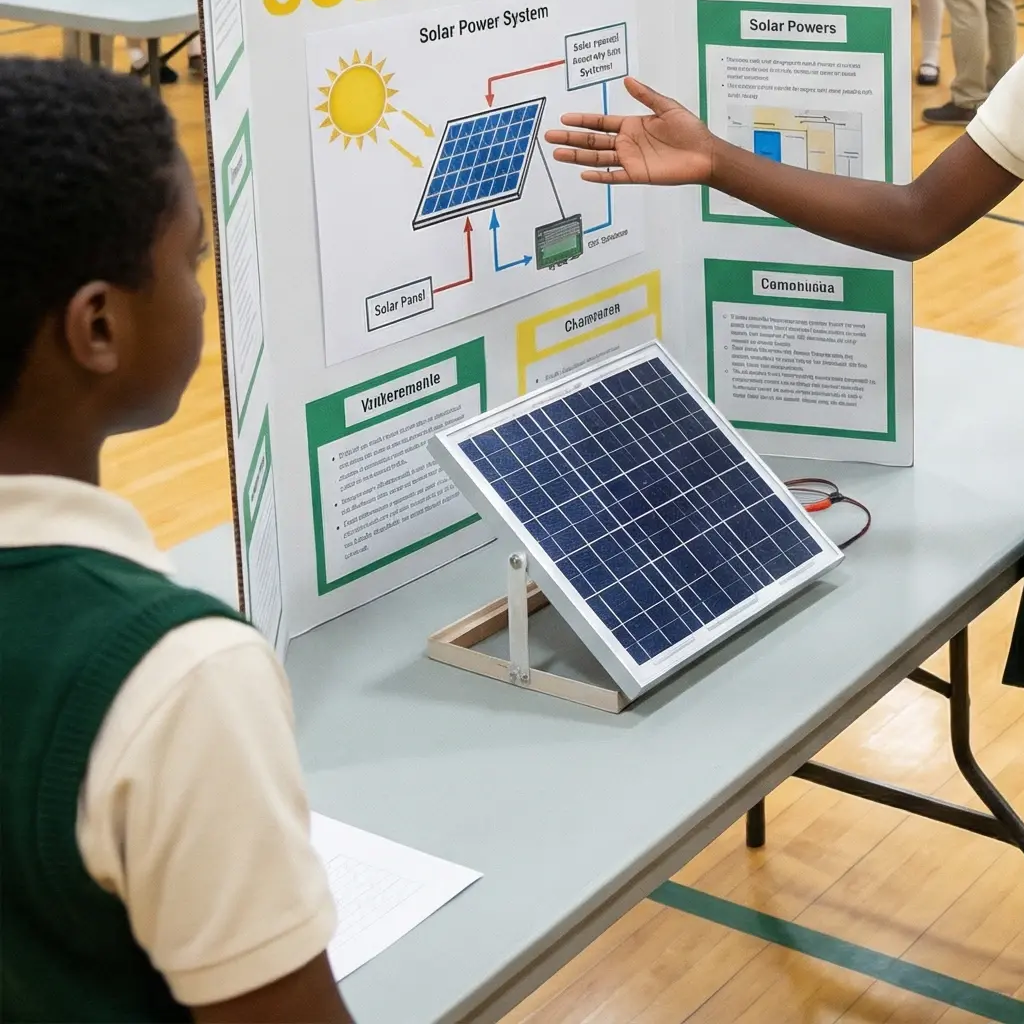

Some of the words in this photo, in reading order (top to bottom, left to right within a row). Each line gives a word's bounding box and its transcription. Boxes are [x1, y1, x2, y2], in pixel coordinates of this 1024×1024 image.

[419, 24, 455, 43] Solar
[459, 16, 500, 35] Power
[503, 6, 549, 28] System
[749, 18, 785, 31] Solar
[788, 20, 837, 34] Powers
[374, 301, 399, 317] Solar
